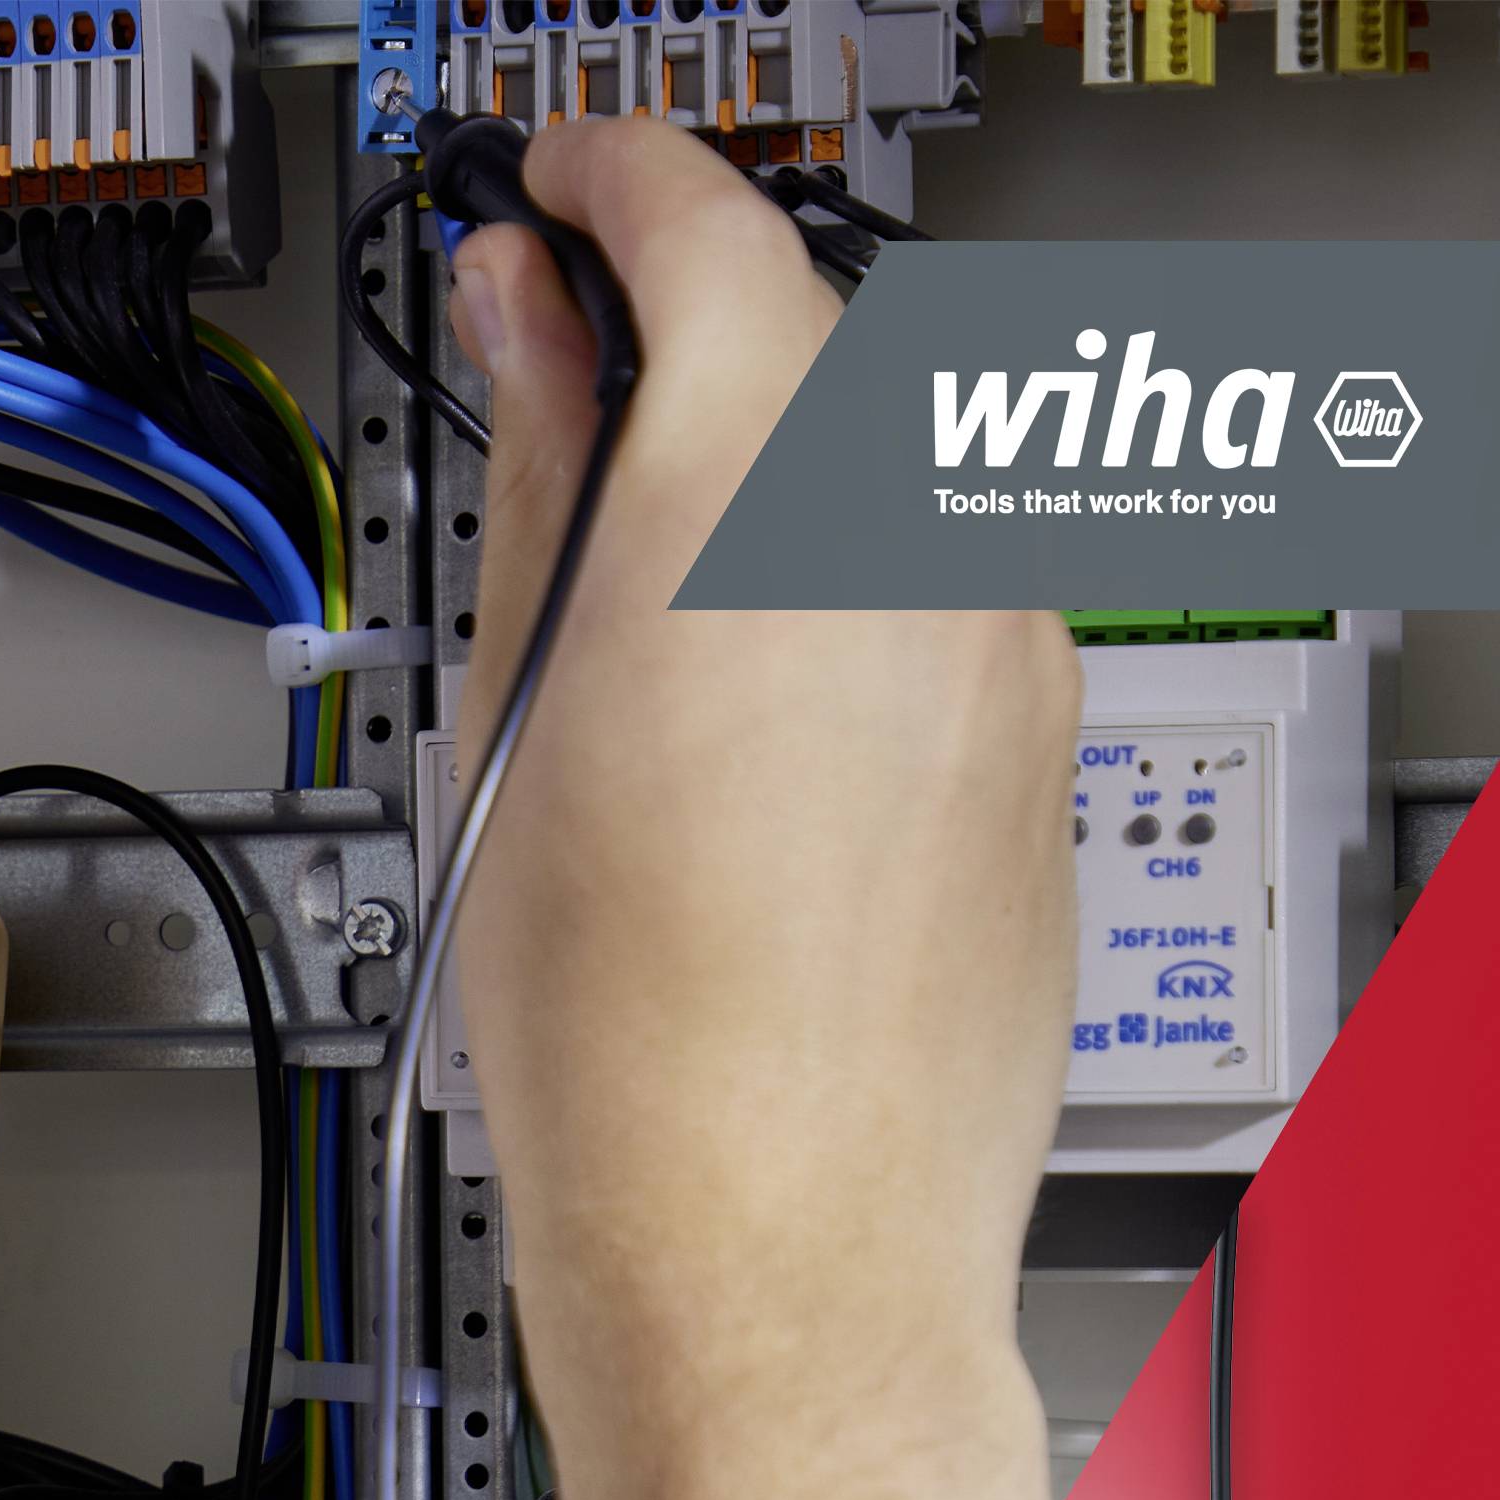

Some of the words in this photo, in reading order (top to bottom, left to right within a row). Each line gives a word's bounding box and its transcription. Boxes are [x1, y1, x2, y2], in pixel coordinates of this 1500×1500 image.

[1080, 744, 1138, 767] OUT
[1134, 790, 1161, 806] UP
[1186, 789, 1216, 804] DN
[1147, 858, 1202, 878] CH6
[1108, 926, 1237, 948] J6F10H-E
[1157, 972, 1235, 999] KNX
[1154, 1016, 1235, 1047] Janke
